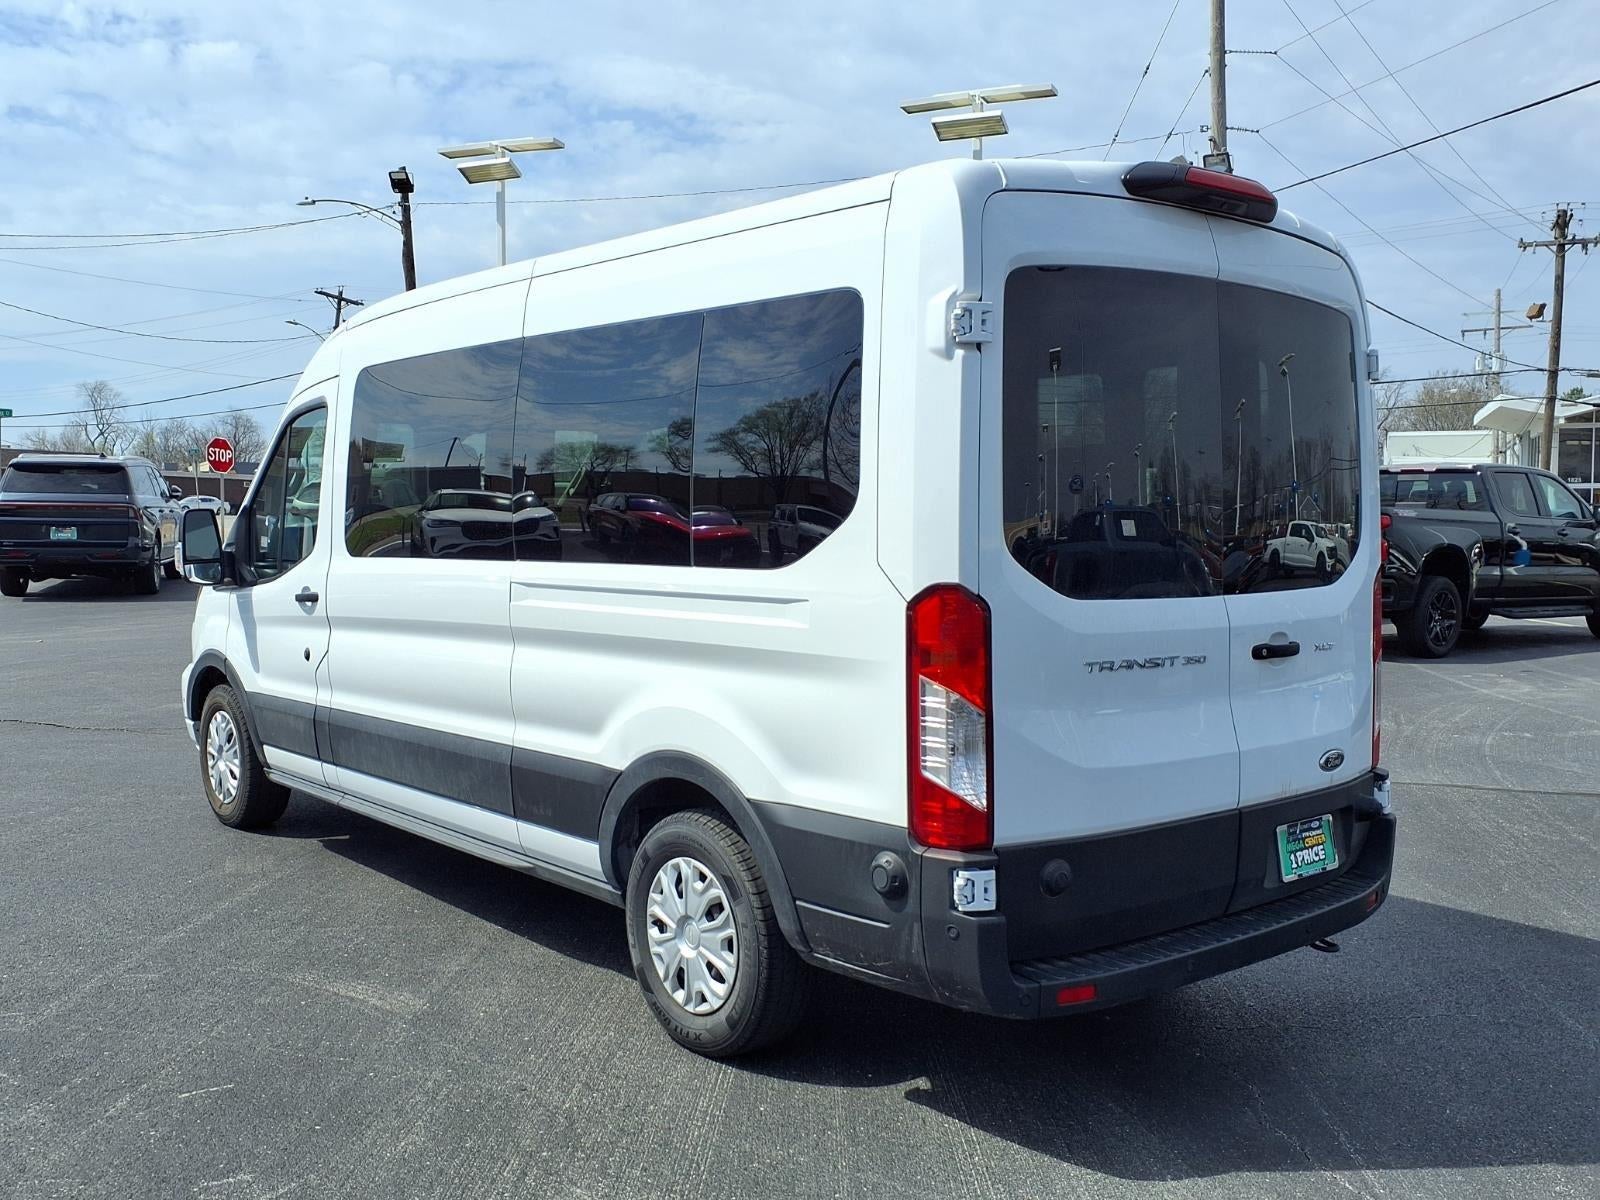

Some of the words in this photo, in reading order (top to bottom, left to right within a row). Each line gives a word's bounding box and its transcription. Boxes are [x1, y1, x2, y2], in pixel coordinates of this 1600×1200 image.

[208, 447, 233, 463] STOP
[1313, 641, 1334, 651] XLT
[1083, 656, 1180, 674] TRANSIT
[1181, 655, 1207, 666] 350
[1296, 845, 1326, 867] PRICE
